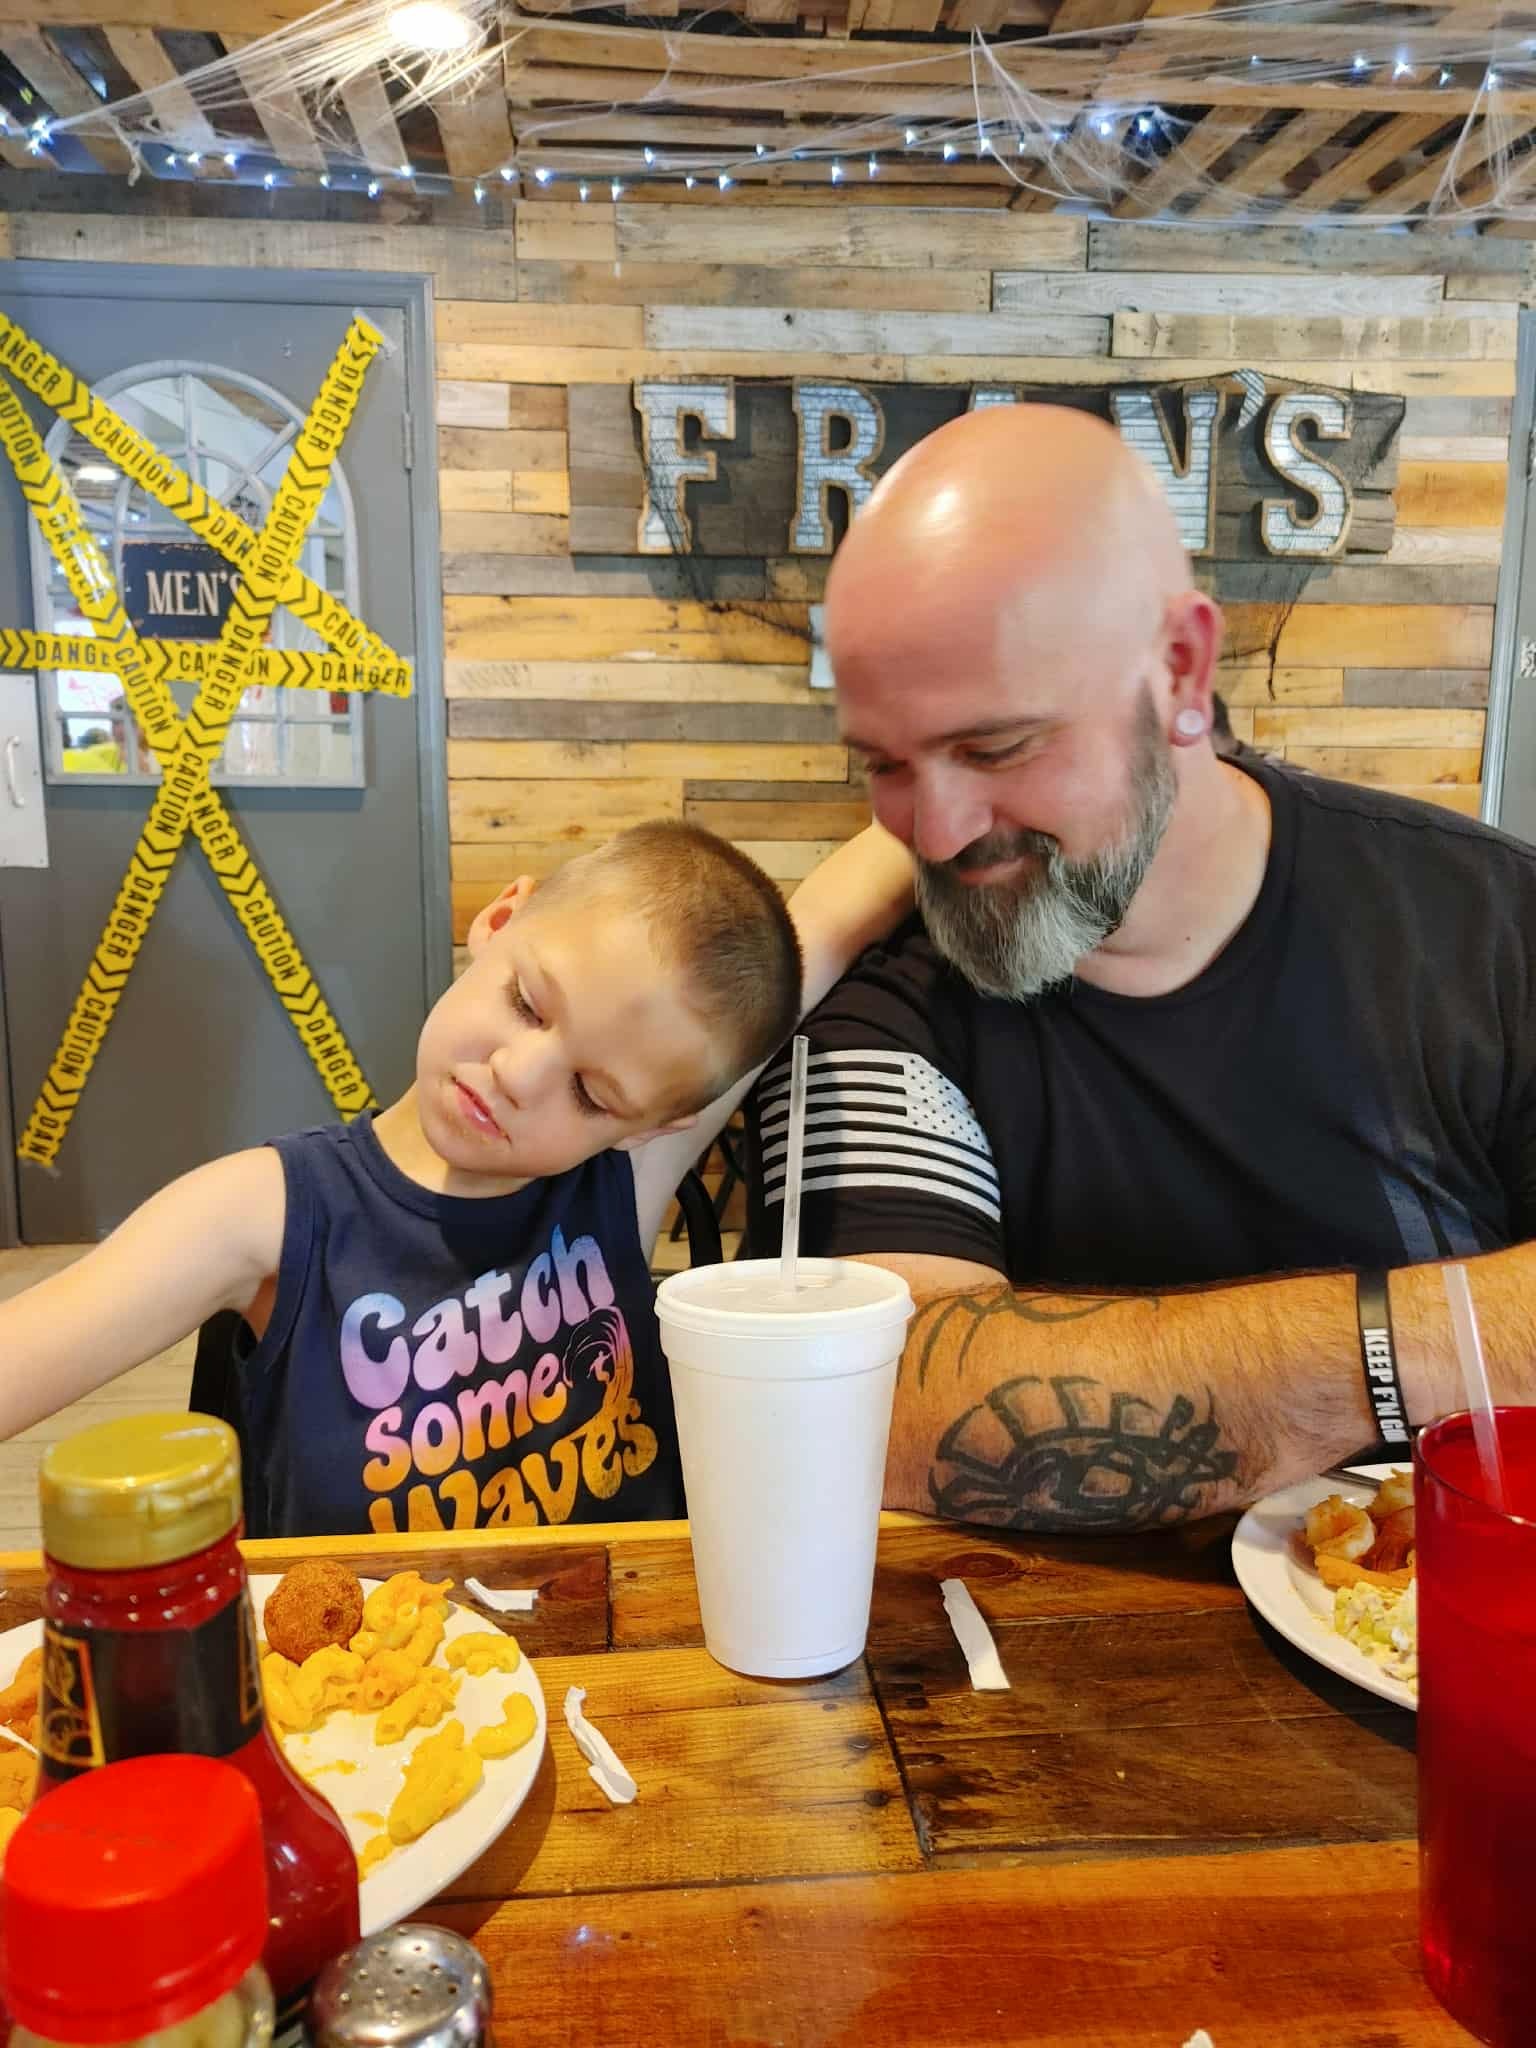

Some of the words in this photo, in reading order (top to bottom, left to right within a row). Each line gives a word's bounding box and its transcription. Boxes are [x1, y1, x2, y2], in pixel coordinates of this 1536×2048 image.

[0, 331, 62, 394] ANGER
[93, 416, 177, 493] CAUTION
[208, 516, 254, 559] DAN
[308, 364, 360, 451] DANGER
[633, 368, 1353, 556] FRN'S
[256, 494, 306, 583] CAUTION
[205, 624, 254, 711] DANGER
[321, 661, 408, 688] DANGER
[154, 751, 203, 836] CAUTION
[114, 647, 172, 734] CAUTION
[193, 792, 237, 861] NGER
[243, 899, 299, 982] CAUTION
[306, 1017, 359, 1097] DANGER
[106, 876, 155, 959] DANGER
[59, 997, 107, 1078] CAUTION
[340, 1223, 615, 1410] Catch
[1362, 1327, 1394, 1384] KEEP
[362, 1352, 568, 1493] some
